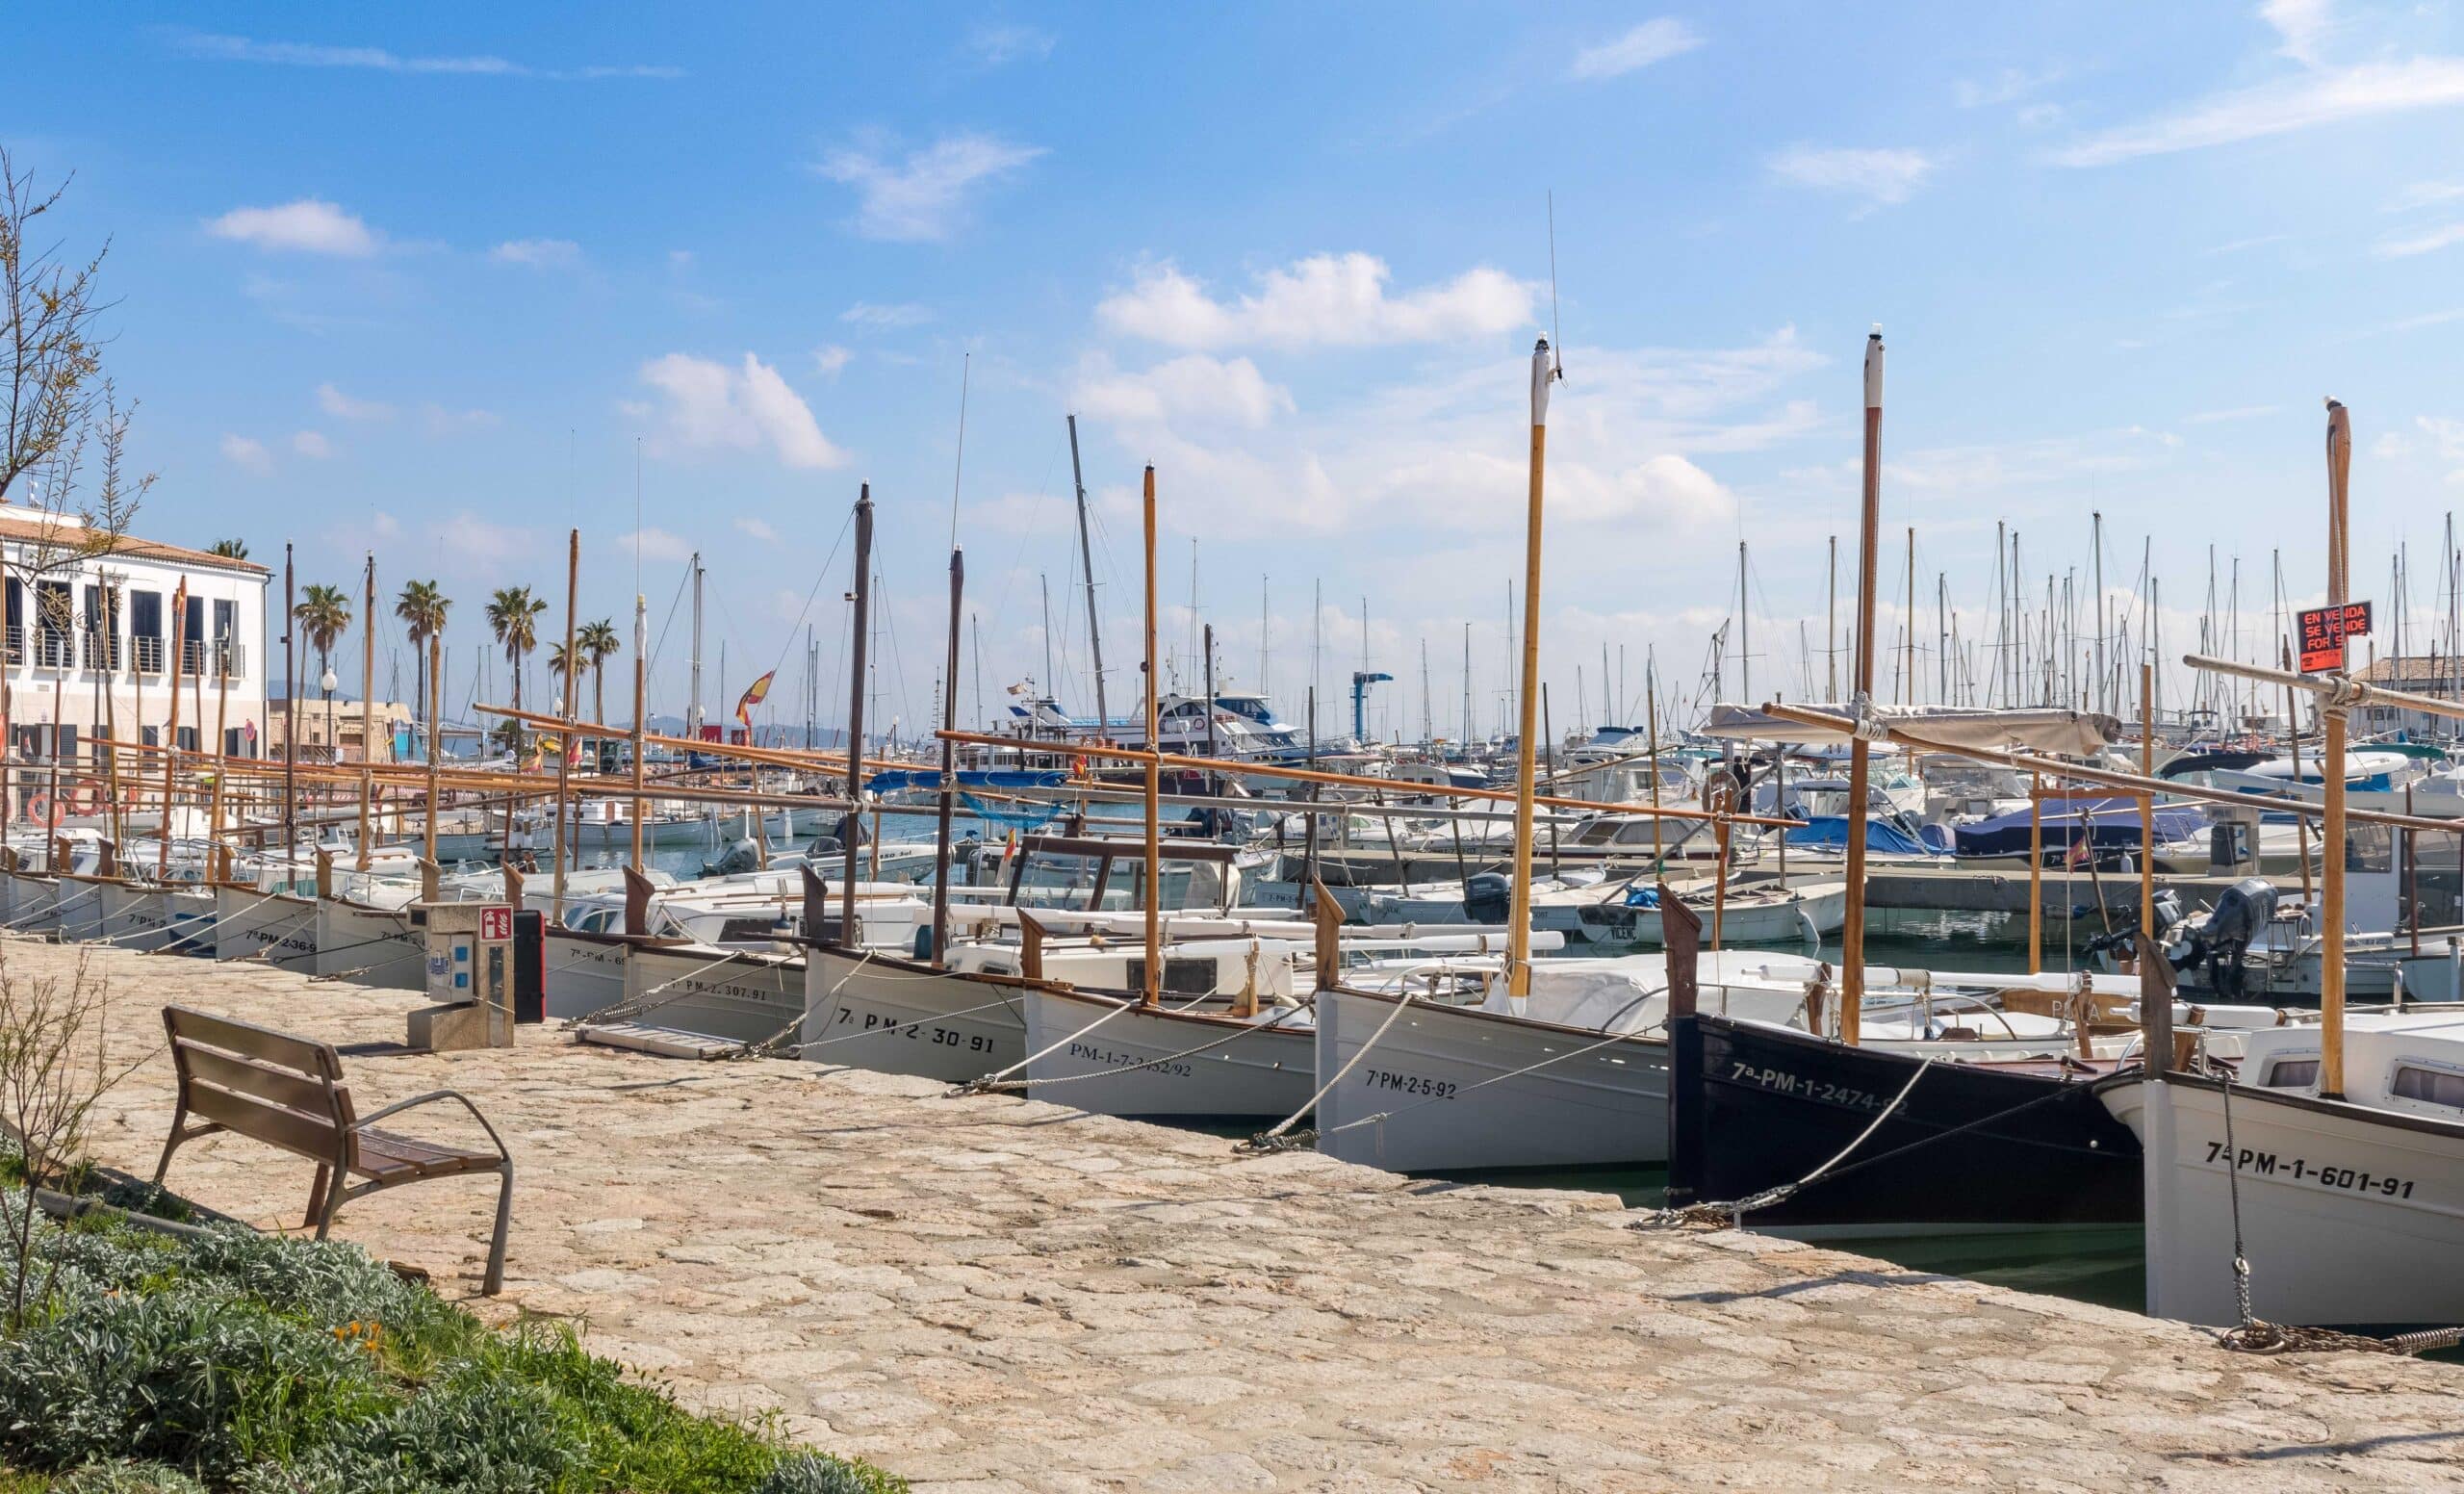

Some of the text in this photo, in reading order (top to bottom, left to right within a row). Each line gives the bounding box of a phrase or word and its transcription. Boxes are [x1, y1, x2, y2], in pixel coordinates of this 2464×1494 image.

[2303, 605, 2366, 625] EN VENDA
[2305, 618, 2366, 637] SE VENDE
[2307, 637, 2330, 651] FOR
